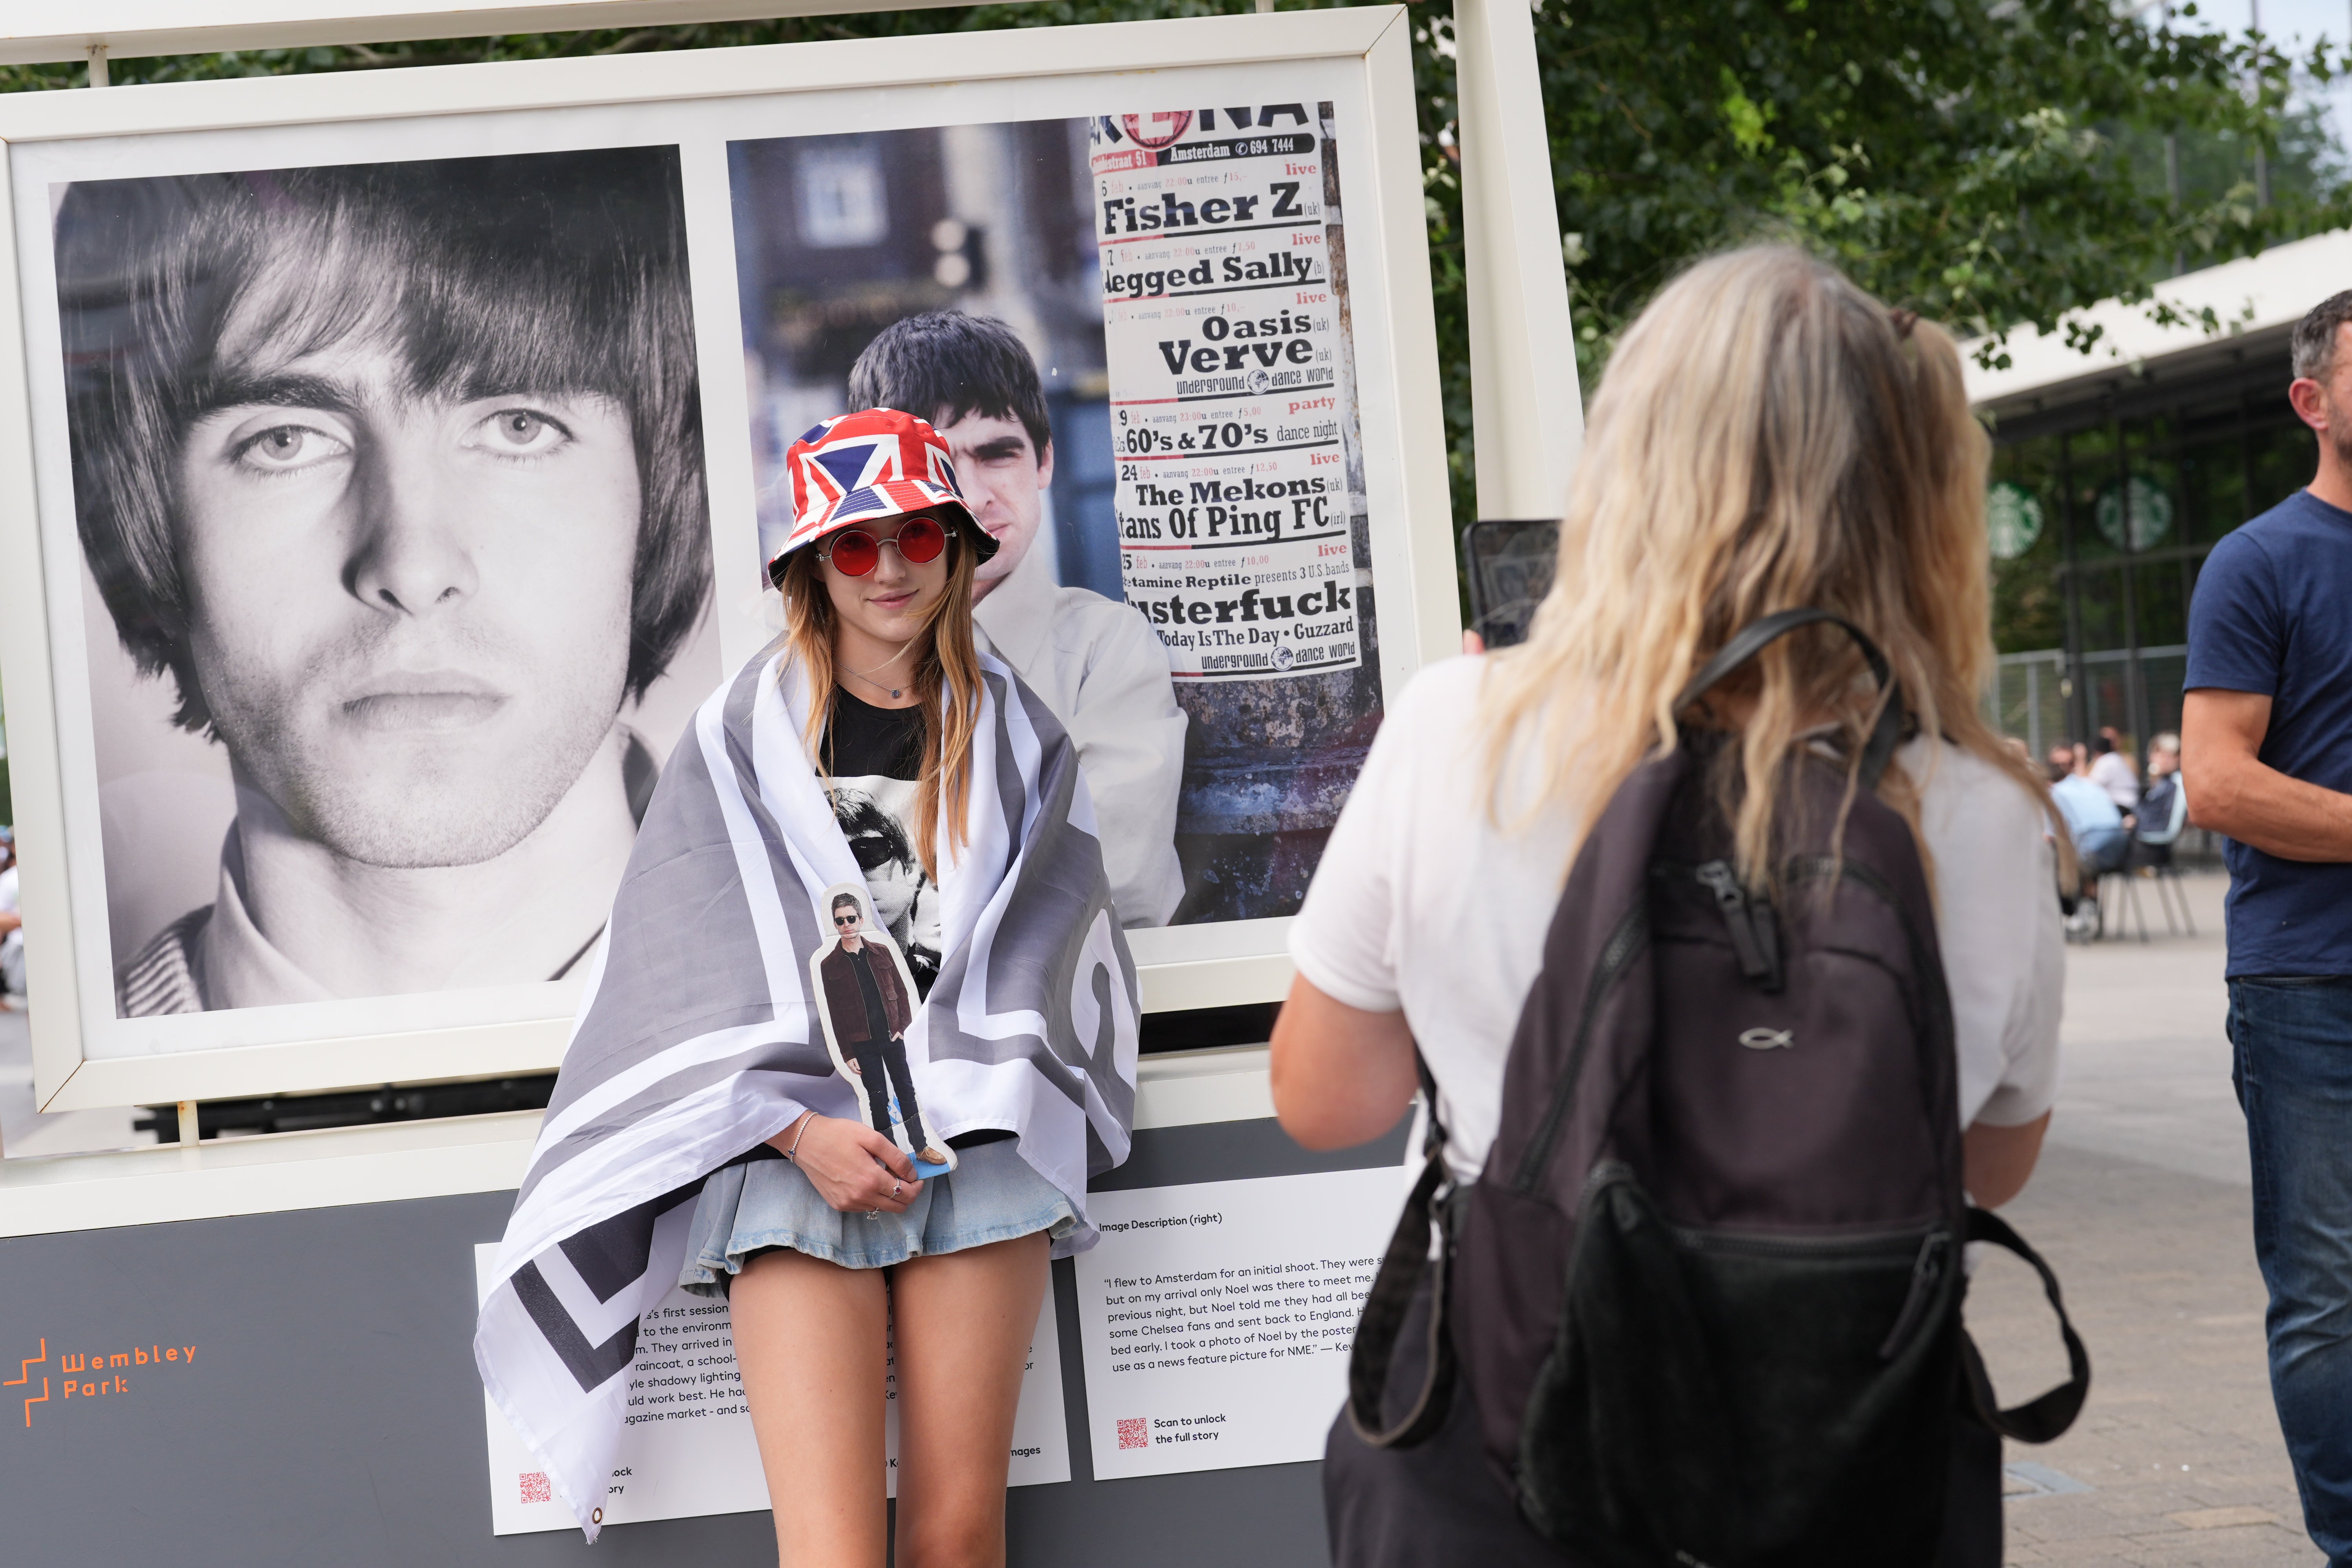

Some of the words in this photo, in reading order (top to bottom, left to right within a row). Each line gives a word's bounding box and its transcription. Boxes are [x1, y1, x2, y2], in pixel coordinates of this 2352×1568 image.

[1171, 143, 1230, 162] Amsterdam
[1250, 140, 1267, 154] 694
[1272, 138, 1294, 152] 7444
[1285, 163, 1316, 175] live
[1138, 181, 1161, 190] aanvang
[1197, 176, 1218, 184] entree
[1104, 192, 1258, 234] Fisher
[1270, 181, 1303, 218] Z
[1292, 233, 1321, 245] live
[1145, 251, 1170, 260] aanvang
[1205, 245, 1227, 254] entree
[1223, 252, 1312, 283] Sally
[1296, 292, 1327, 304] live
[1138, 310, 1161, 320] aanvang
[1194, 307, 1216, 315] entree
[1202, 309, 1311, 341] Oasis
[1158, 339, 1313, 375] Verve
[1177, 376, 1244, 394] underground
[1272, 370, 1301, 386] dance
[1307, 367, 1333, 382] world
[1289, 396, 1335, 414] party
[1152, 414, 1176, 423] aanvang
[1211, 410, 1233, 419] entree
[1127, 428, 1173, 454] 60's
[1178, 433, 1196, 450] &
[1198, 422, 1268, 450] 70's
[1277, 425, 1309, 441] dance
[1313, 419, 1338, 440] night
[1310, 453, 1339, 465] live
[1122, 465, 1138, 481] 24
[1140, 466, 1150, 479] feb
[1163, 470, 1188, 479] aanvang
[1223, 466, 1245, 474] entree
[1136, 484, 1184, 506] The
[1190, 477, 1325, 504] Mekons
[1169, 507, 1200, 539] Of
[1206, 505, 1281, 540] Ping
[1292, 496, 1329, 529] FC
[1318, 544, 1347, 557] live
[1136, 556, 1147, 568] feb
[1159, 562, 1181, 570] aanvang
[1185, 573, 1251, 590] Reptile
[1255, 570, 1296, 586] presents
[1300, 567, 1306, 579] 3
[1157, 630, 1194, 651] Today
[1198, 631, 1212, 646] Is
[1213, 630, 1245, 645] The
[1248, 628, 1279, 647] Day
[1294, 615, 1353, 639] Guzzard
[1201, 653, 1268, 669] underground
[1296, 647, 1324, 663] dance
[1329, 641, 1355, 659] world
[1099, 1223, 1129, 1232] Image
[1131, 1217, 1187, 1229] Description
[1190, 1212, 1222, 1226] (right)
[1114, 1278, 1137, 1287] flew
[1140, 1277, 1152, 1285] to
[1155, 1271, 1217, 1284] Amsterdam
[1220, 1269, 1235, 1278] for
[1254, 1264, 1282, 1275] initial
[1285, 1262, 1318, 1272] shoot.
[1320, 1259, 1345, 1269] They
[1348, 1258, 1374, 1267] were
[1106, 1296, 1125, 1305] but
[1145, 1294, 1160, 1303] my
[1165, 1288, 1197, 1300] arrival
[1200, 1287, 1222, 1297] only
[1225, 1284, 1249, 1294] Noel
[1252, 1284, 1273, 1292] was
[1276, 1281, 1305, 1290] there
[1308, 1279, 1320, 1287] to
[1324, 1276, 1351, 1285] meet
[663, 1308, 686, 1318] first
[690, 1304, 728, 1316] session
[1108, 1310, 1152, 1324] previous
[1156, 1307, 1186, 1319] night,
[1189, 1305, 1208, 1314] but
[1212, 1301, 1235, 1312] Noel
[1239, 1299, 1260, 1310] told
[1284, 1296, 1308, 1306] they
[1312, 1293, 1332, 1303] had
[1336, 1291, 1347, 1301] all
[643, 1328, 656, 1336] to
[660, 1325, 679, 1334] the
[1109, 1329, 1138, 1338] some
[1142, 1325, 1183, 1335] Chelsea
[1187, 1322, 1210, 1331] fans
[1214, 1319, 1234, 1329] and
[1238, 1317, 1261, 1327] sent
[1265, 1314, 1290, 1324] back
[1310, 1308, 1354, 1321] England.
[651, 1343, 678, 1353] They
[682, 1338, 719, 1350] arrived
[722, 1337, 732, 1347] in
[1111, 1345, 1131, 1355] bed
[1134, 1343, 1162, 1353] early.
[1171, 1339, 1196, 1349] took
[1209, 1337, 1240, 1348] photo
[1244, 1334, 1254, 1343] of
[1258, 1331, 1281, 1342] Noel
[1285, 1330, 1298, 1341] by
[1301, 1328, 1319, 1338] the
[1322, 1326, 1356, 1338] poster
[62, 1345, 196, 1373] Wembley
[635, 1359, 684, 1371] raincoat,
[1158, 1359, 1185, 1368] news
[1187, 1354, 1227, 1365] feature
[1230, 1351, 1267, 1363] picture
[1270, 1348, 1285, 1357] for
[64, 1376, 129, 1398] Park
[648, 1376, 696, 1387] shadowy
[700, 1371, 740, 1385] lighting
[648, 1393, 675, 1404] work
[679, 1391, 706, 1401] best.
[710, 1389, 724, 1399] He
[667, 1408, 707, 1420] market
[717, 1404, 737, 1415] and
[1154, 1419, 1178, 1428] Scan
[1194, 1414, 1226, 1424] unlock
[1156, 1435, 1172, 1444] the
[1175, 1432, 1190, 1442] full
[1192, 1432, 1219, 1440] story
